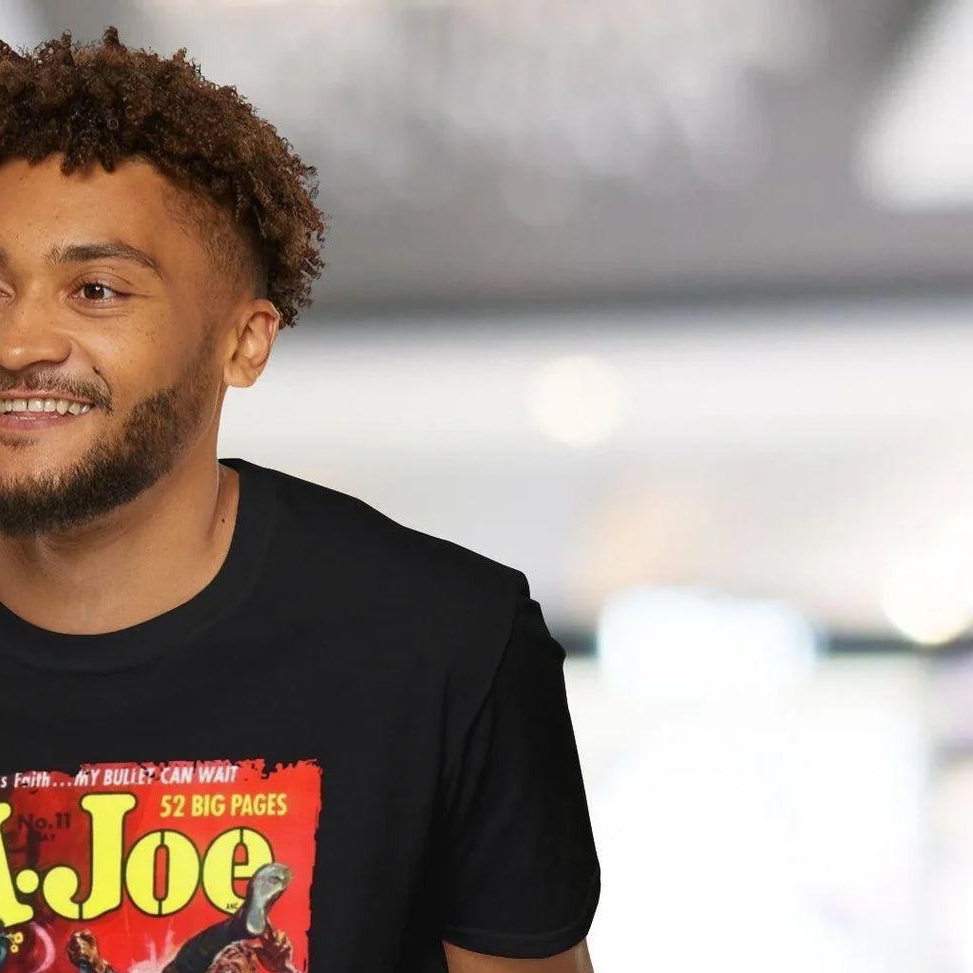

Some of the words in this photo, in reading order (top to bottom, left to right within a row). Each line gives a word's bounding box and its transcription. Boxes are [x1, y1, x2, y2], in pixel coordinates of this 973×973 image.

[160, 766, 195, 785] CAN
[198, 765, 239, 784] WAIT
[159, 795, 186, 818] 52
[191, 794, 225, 817] BIG
[231, 792, 287, 817] PAGES
